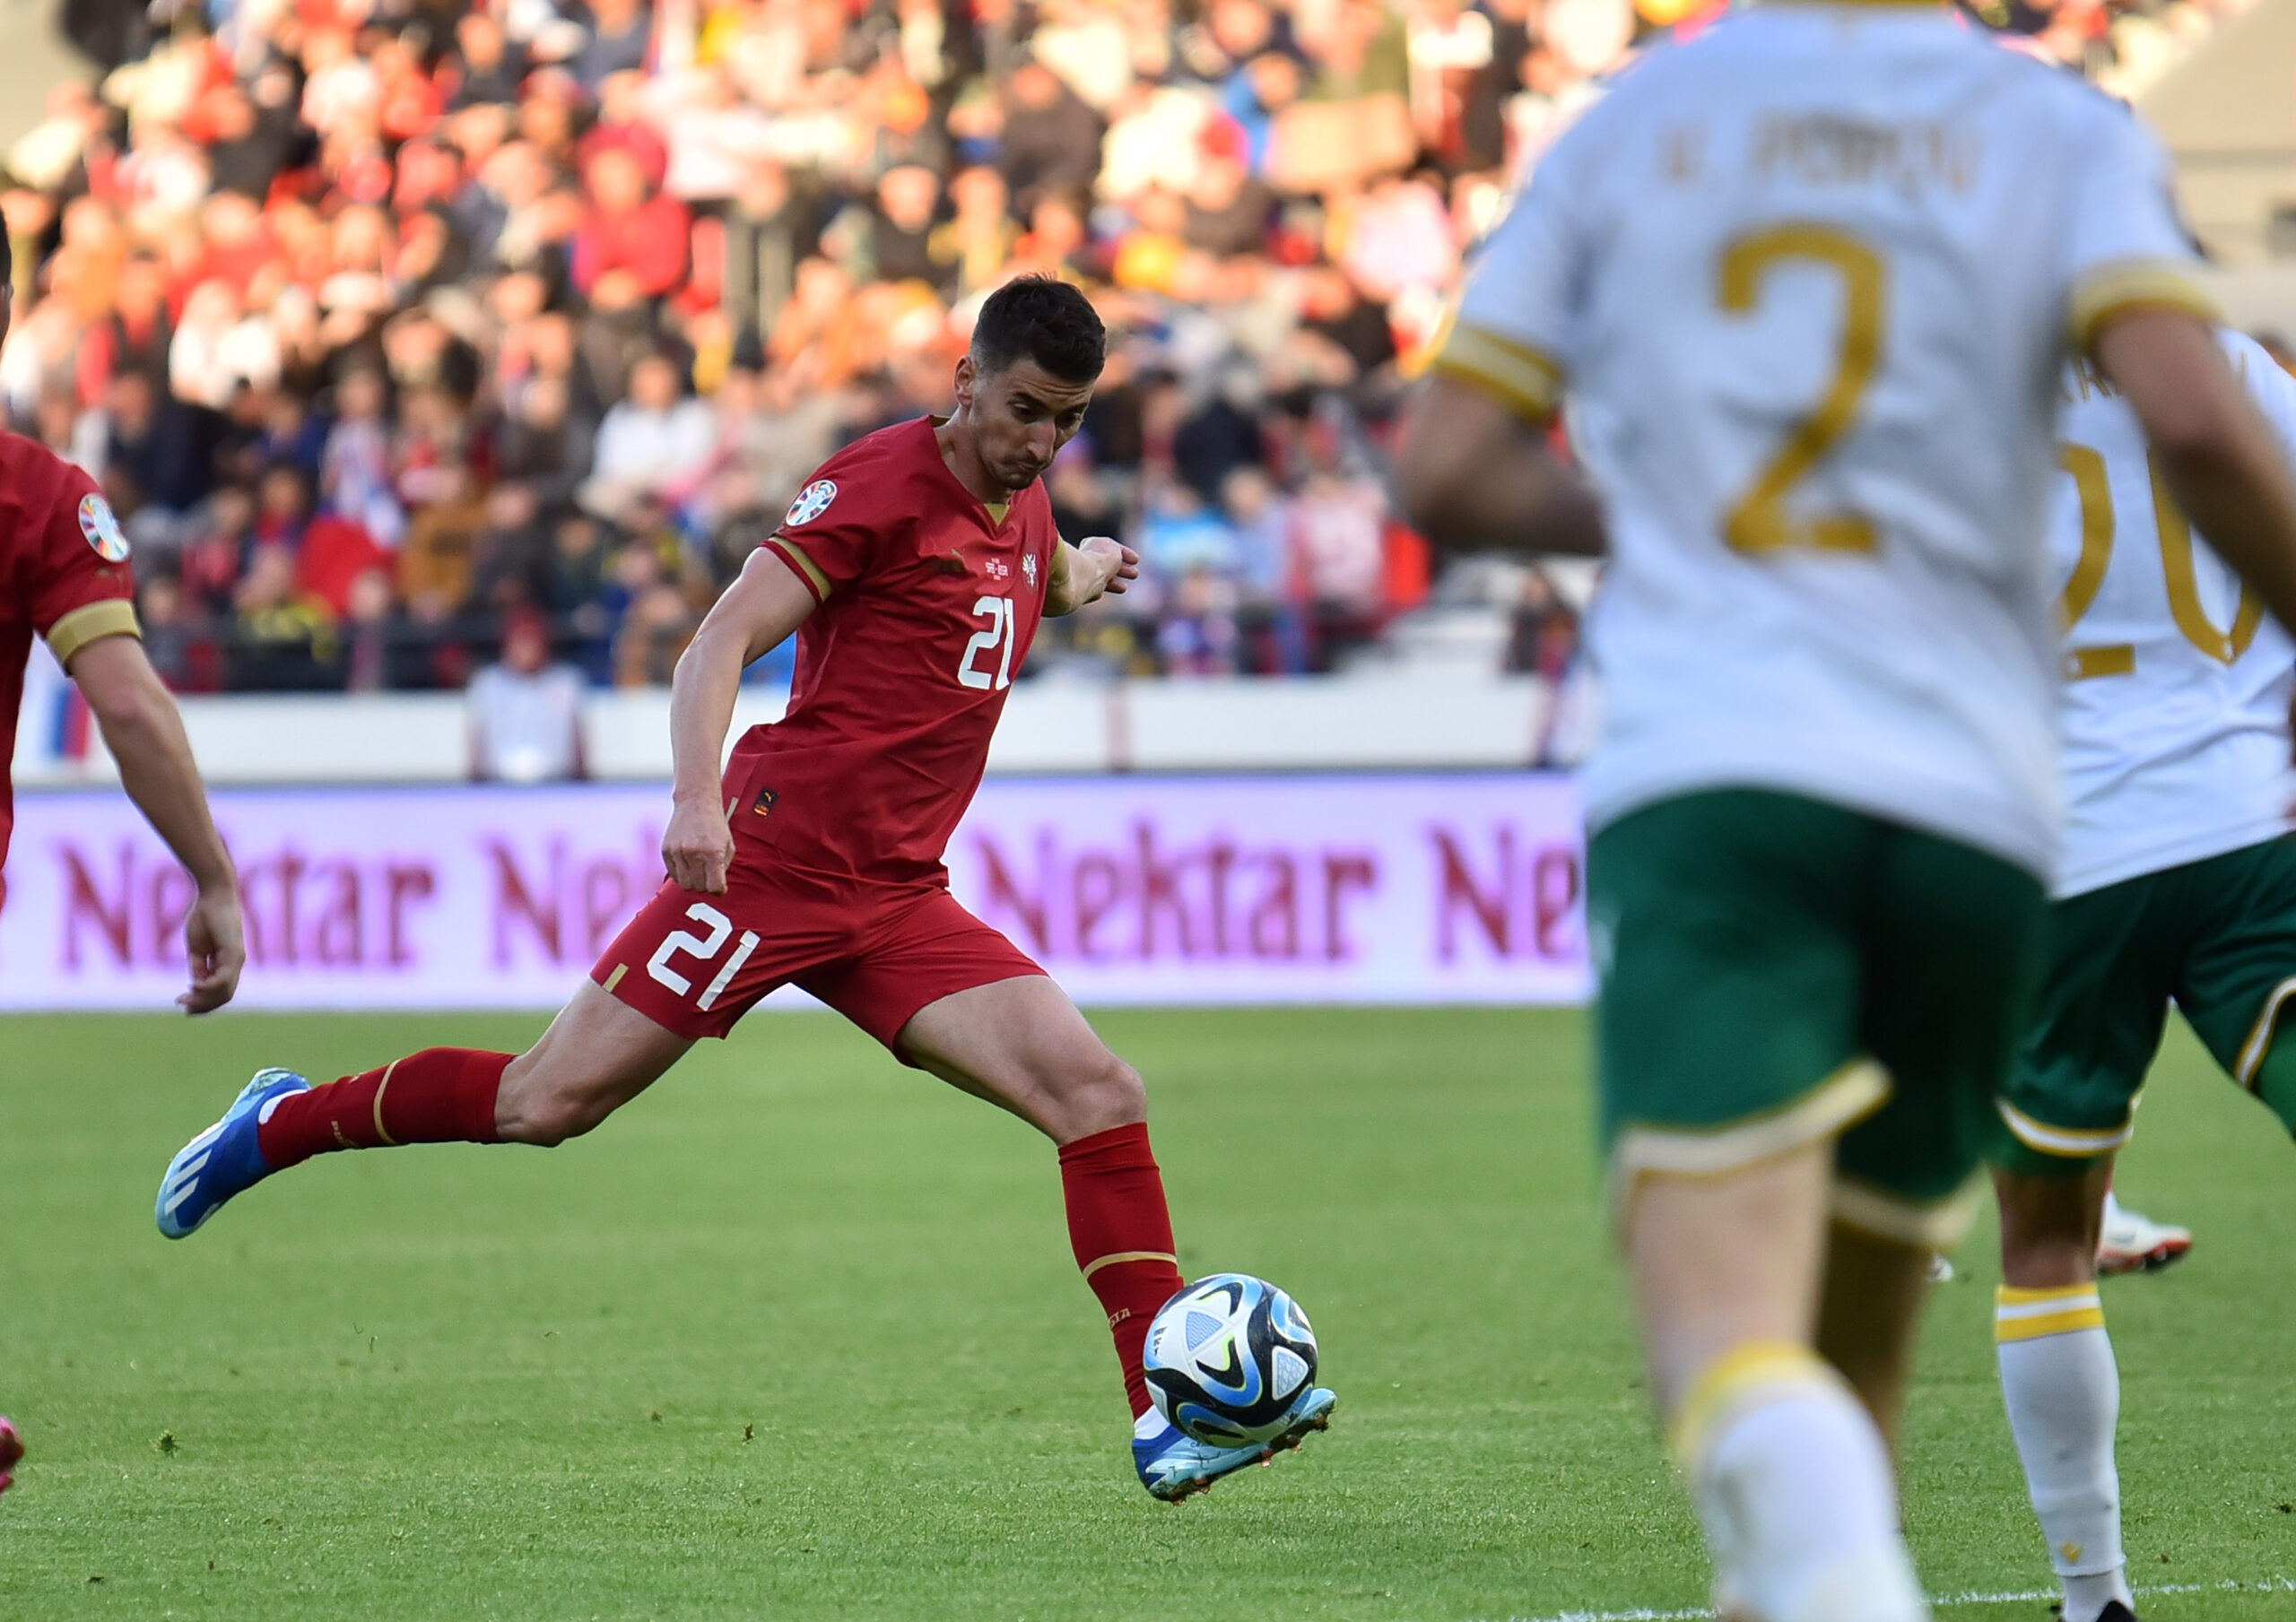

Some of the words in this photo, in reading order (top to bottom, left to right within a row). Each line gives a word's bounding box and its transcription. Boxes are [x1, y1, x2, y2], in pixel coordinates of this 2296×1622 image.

[1718, 221, 1888, 554] 2
[958, 595, 1014, 690] 21
[59, 832, 436, 968] Netar
[647, 902, 761, 1011] 21
[972, 820, 1376, 961] Nektar
